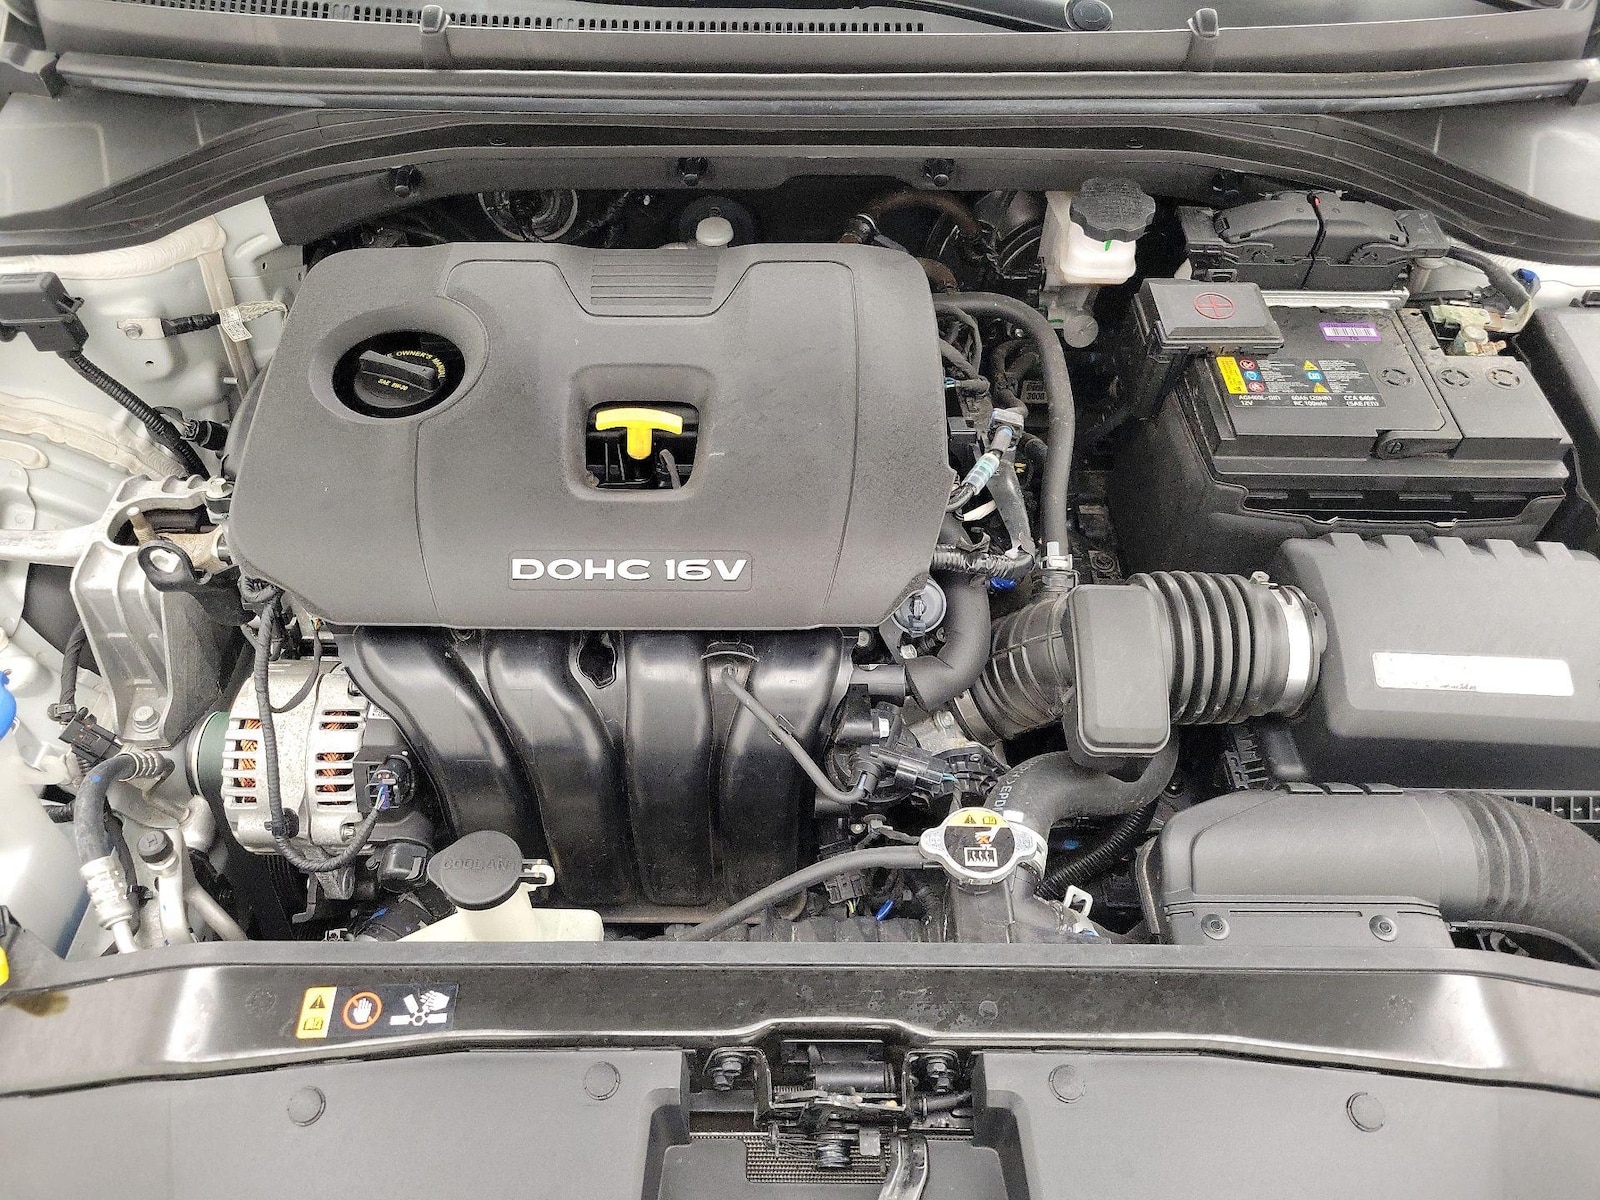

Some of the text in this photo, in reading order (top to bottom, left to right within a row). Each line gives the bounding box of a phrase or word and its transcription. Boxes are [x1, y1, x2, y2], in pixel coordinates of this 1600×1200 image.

[396, 350, 433, 360] OWNER'S
[378, 378, 391, 386] SAE
[511, 558, 748, 582] DOHC 16V
[443, 858, 518, 871] COOLANT
